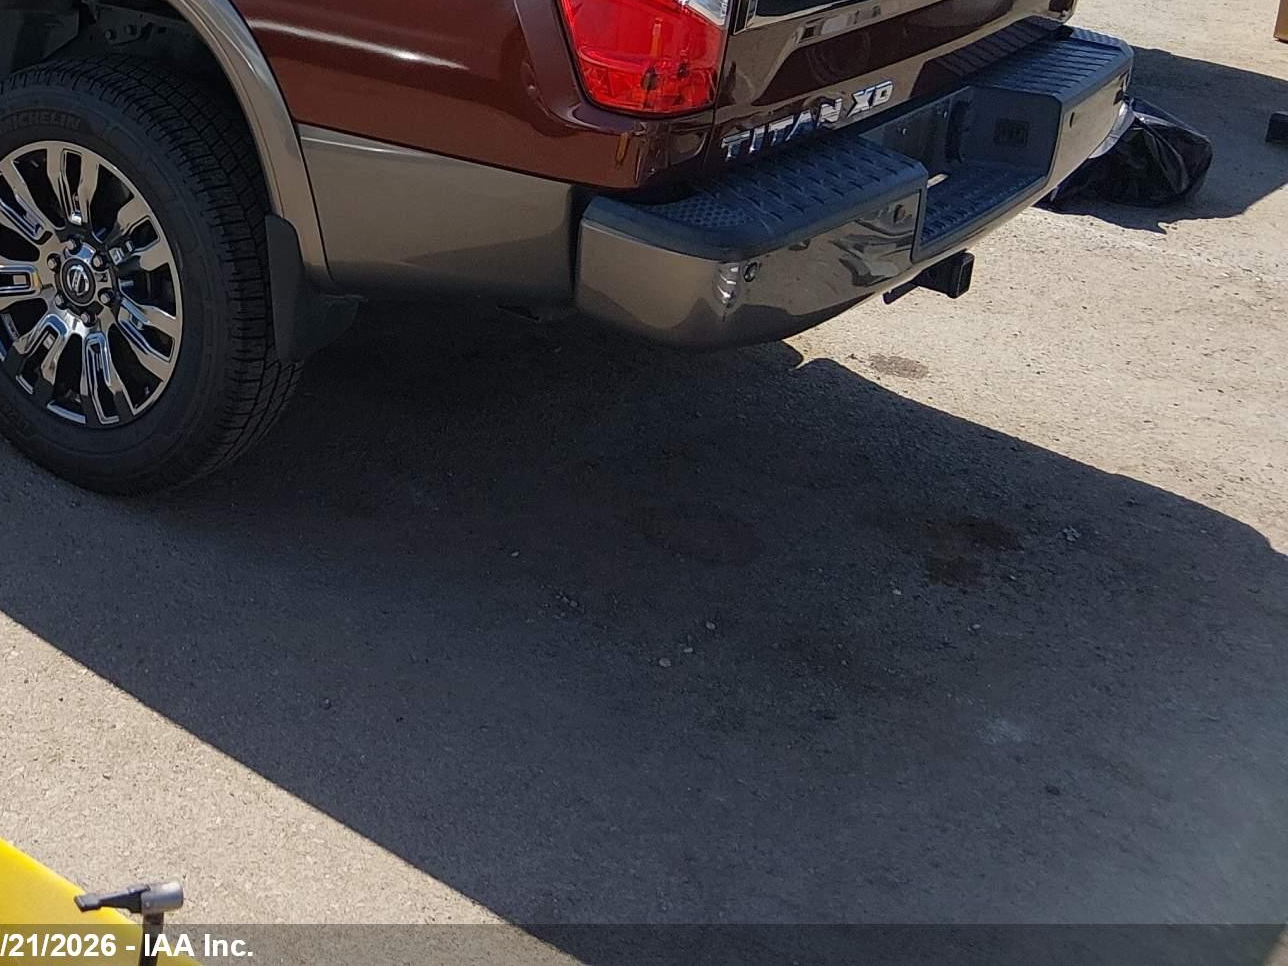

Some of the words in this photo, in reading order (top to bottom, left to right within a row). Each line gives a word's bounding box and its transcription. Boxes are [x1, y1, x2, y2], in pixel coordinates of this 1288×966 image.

[0, 109, 82, 135] MICHELIN
[721, 96, 844, 162] TITAN
[847, 80, 894, 118] XD
